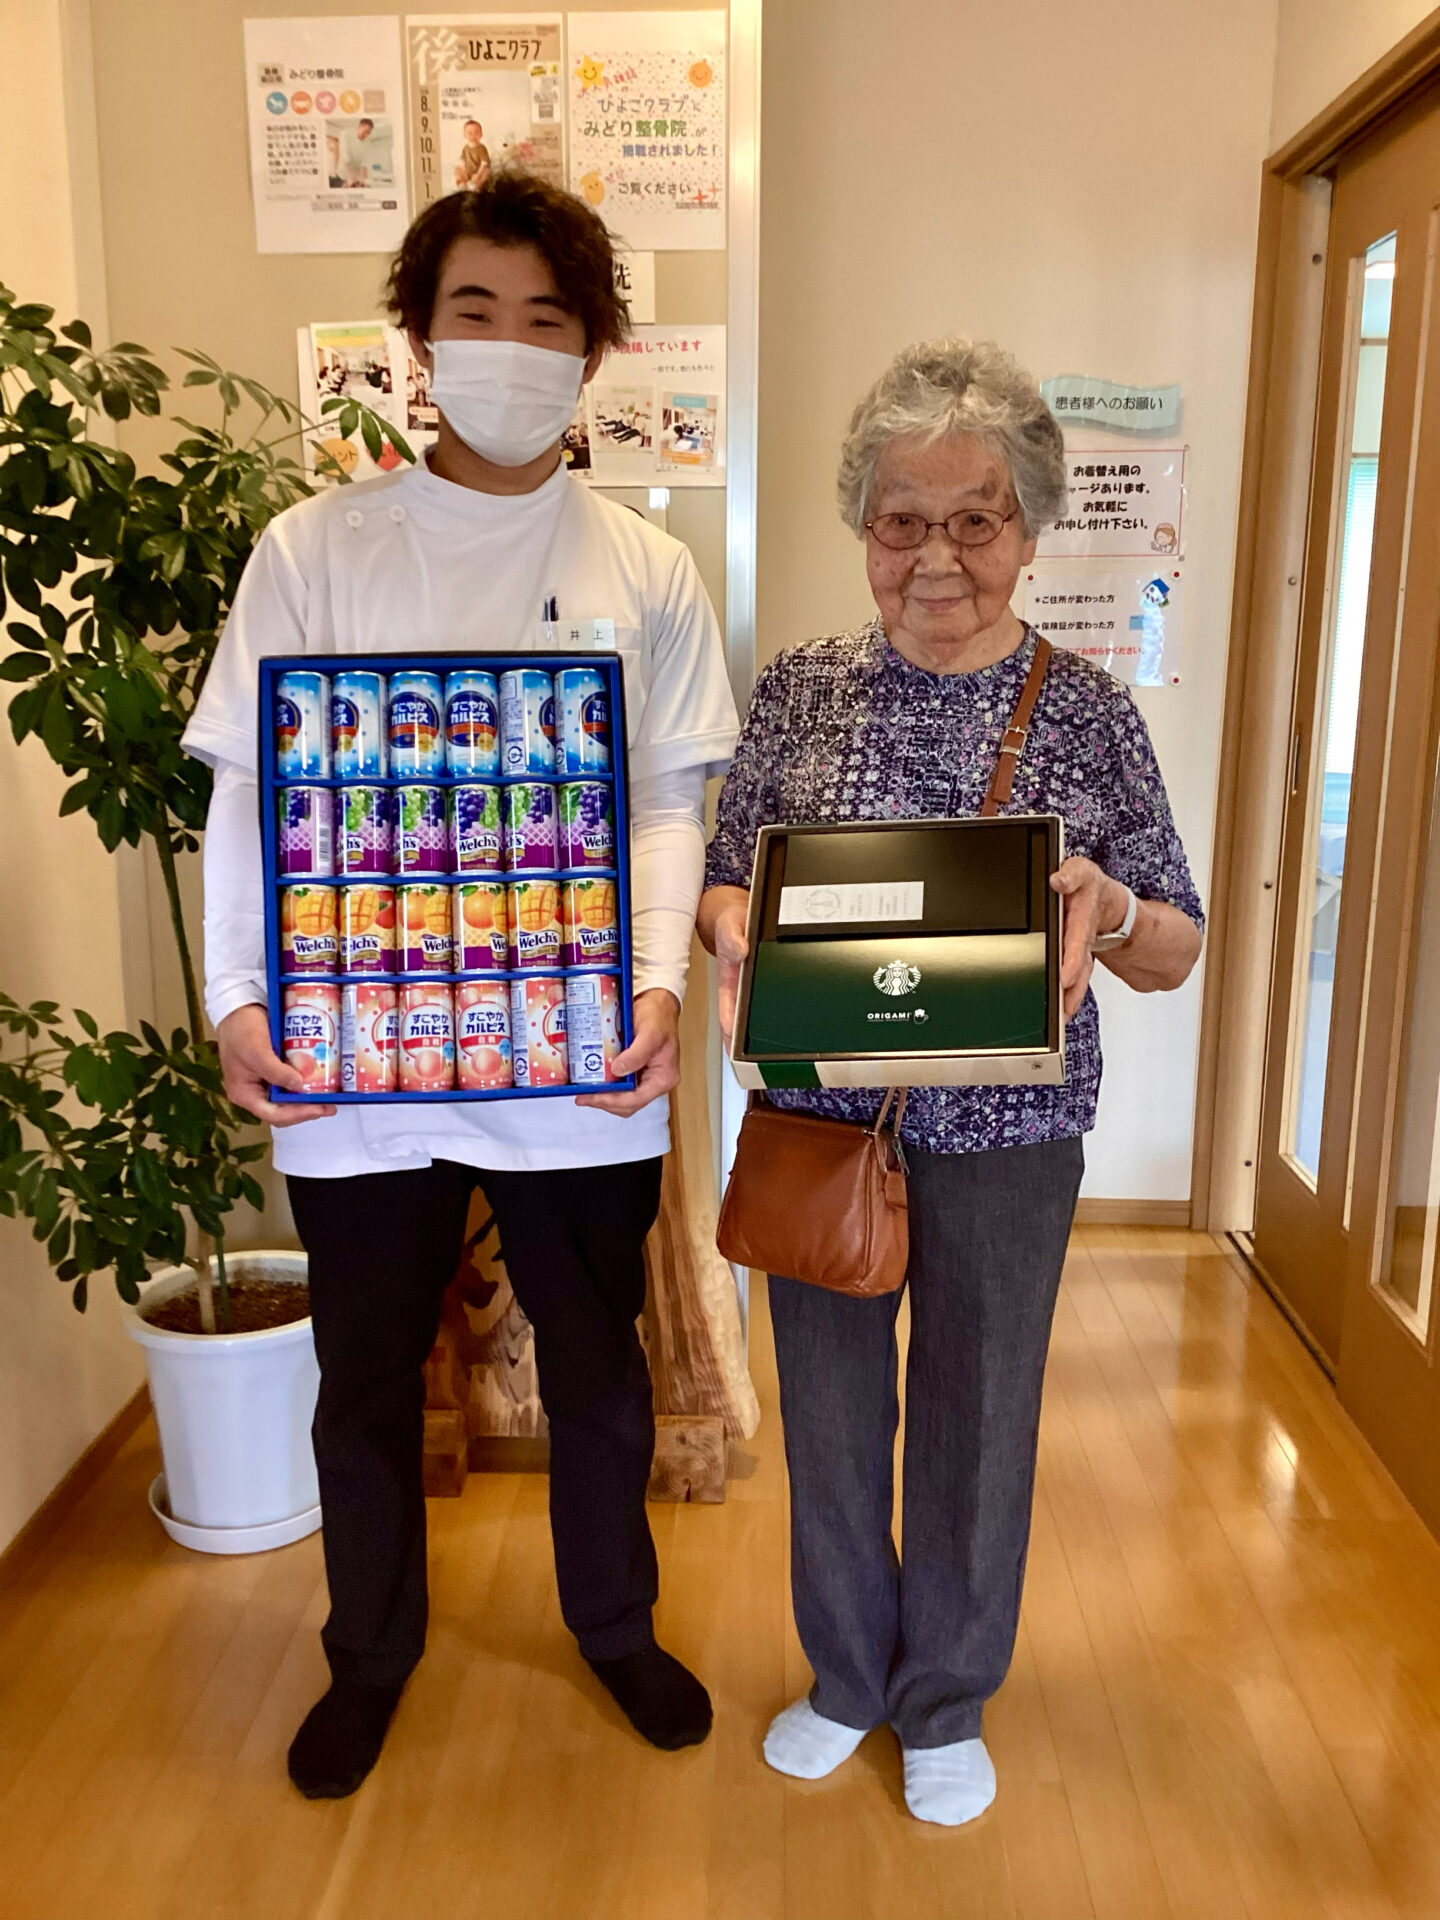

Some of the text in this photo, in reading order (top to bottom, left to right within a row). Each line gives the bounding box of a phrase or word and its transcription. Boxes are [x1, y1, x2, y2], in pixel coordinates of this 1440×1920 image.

[468, 39, 542, 61] ひよこクラブ
[1055, 396, 1163, 410] 患者様へのお願い
[1073, 465, 1141, 477] お着替え用の
[1083, 501, 1128, 512] お気軽に
[1054, 518, 1149, 530] お申し付け下さい。
[392, 701, 427, 714] すこやか
[451, 700, 488, 712] すこやか
[391, 712, 429, 725] カルピス
[451, 711, 490, 724] カルピス
[459, 836, 498, 852] Welch's
[519, 932, 558, 949] Welch's
[412, 1013, 449, 1025] すこやか
[468, 1011, 504, 1022] すこやか
[867, 1012, 911, 1020] ORIGAMI
[410, 1025, 450, 1036] カルピス
[466, 1022, 506, 1034] カルピス
